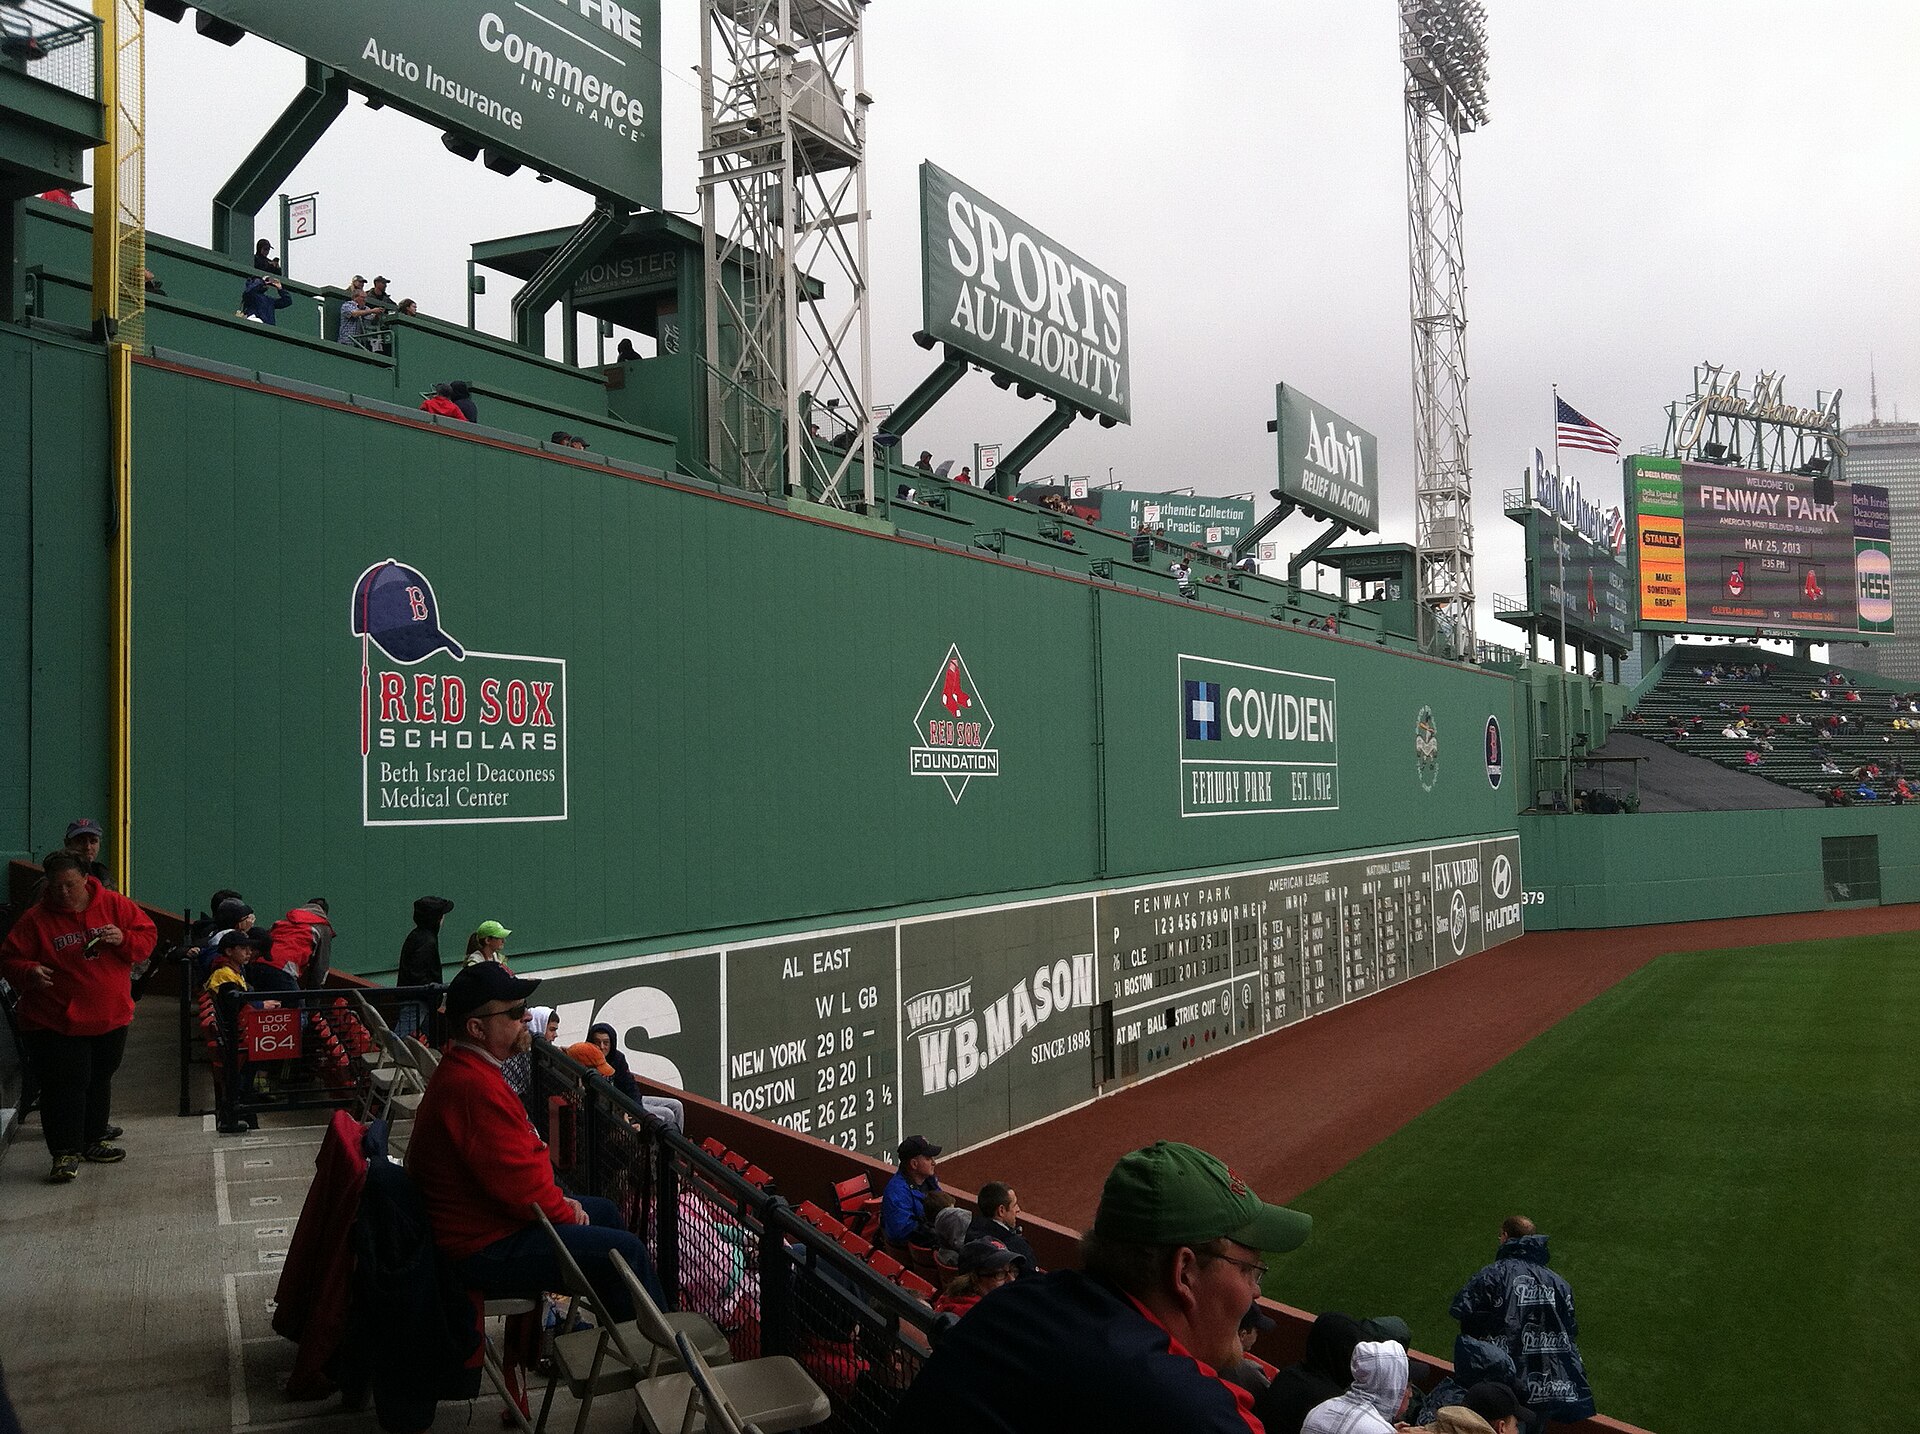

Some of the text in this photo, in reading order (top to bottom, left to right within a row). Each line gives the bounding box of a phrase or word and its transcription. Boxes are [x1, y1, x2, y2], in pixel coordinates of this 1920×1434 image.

[478, 12, 644, 127] Commerce
[362, 37, 523, 131] Auto Insurance
[520, 73, 638, 142] INSURANCE
[296, 217, 307, 234] 2
[574, 250, 676, 286] MONSTER
[947, 191, 1121, 355] SPORTS
[950, 280, 1121, 404] AUTHORITY
[1675, 360, 1849, 457] John Hancock
[1304, 410, 1364, 488] Advil
[986, 457, 994, 468] 5
[1074, 487, 1083, 497] 6
[1301, 469, 1370, 518] RELIEF IN ACTION
[1746, 477, 1794, 492] WELCOME TO
[1199, 504, 1244, 520] Collection
[1700, 485, 1840, 524] FENWAY PARK
[1853, 494, 1868, 505] Beth
[1148, 512, 1155, 521] 7
[1719, 517, 1751, 527] AMERICA'S
[1752, 520, 1767, 529] MOST
[1210, 533, 1217, 541] 8
[1645, 533, 1679, 546] STANLEY
[1745, 538, 1801, 555] MAY 25, 2013
[1776, 559, 1786, 569] PM
[1647, 585, 1681, 596] SOMETHING
[1655, 573, 1672, 582] MAKE
[1859, 572, 1890, 600] HESS
[405, 585, 428, 621] B
[378, 671, 556, 727] RED SOX
[1225, 687, 1334, 743] COVIDIEN
[379, 728, 557, 750] SCHOLARS
[929, 720, 982, 747] RED SOX
[380, 761, 556, 783] Beth Israel Deaconess
[914, 753, 996, 770] FOUNDATION
[380, 786, 510, 809] Medical Center
[1192, 771, 1239, 804] FENWAY
[1244, 771, 1272, 802] PARK
[1268, 875, 1303, 892] AMERICAN
[1453, 858, 1479, 886] WEBB
[1134, 885, 1231, 915] FENWAY PARK
[1234, 905, 1239, 919] R
[1251, 902, 1256, 916] E
[1522, 892, 1545, 905] 379
[1113, 927, 1120, 944] P
[1272, 919, 1284, 934] TEX
[782, 947, 851, 980] AL EAST
[1131, 947, 1147, 967] CLE
[1113, 972, 1153, 998] 31 BOSTON
[816, 985, 878, 1019] W L GB
[906, 984, 972, 1030] WHO BUT
[258, 1013, 292, 1024] LOGE
[262, 1023, 288, 1033] BOX
[1116, 1026, 1126, 1045] AT
[1127, 1021, 1141, 1042] BAT
[1147, 1014, 1167, 1035] BALL
[1175, 1003, 1199, 1026] STRIKE
[1201, 998, 1216, 1017] OUT
[255, 1034, 295, 1052] 164
[731, 1026, 854, 1080] NEW YORK 29 18
[1031, 1029, 1091, 1065] SINCE 1898
[732, 1077, 796, 1113] BOSTON
[817, 1066, 835, 1093] 29
[839, 1060, 856, 1087] 20
[818, 1100, 835, 1129] 26
[840, 1094, 857, 1121] 22
[865, 1088, 875, 1112] 3
[840, 1128, 857, 1151] 23
[865, 1121, 875, 1146] 5
